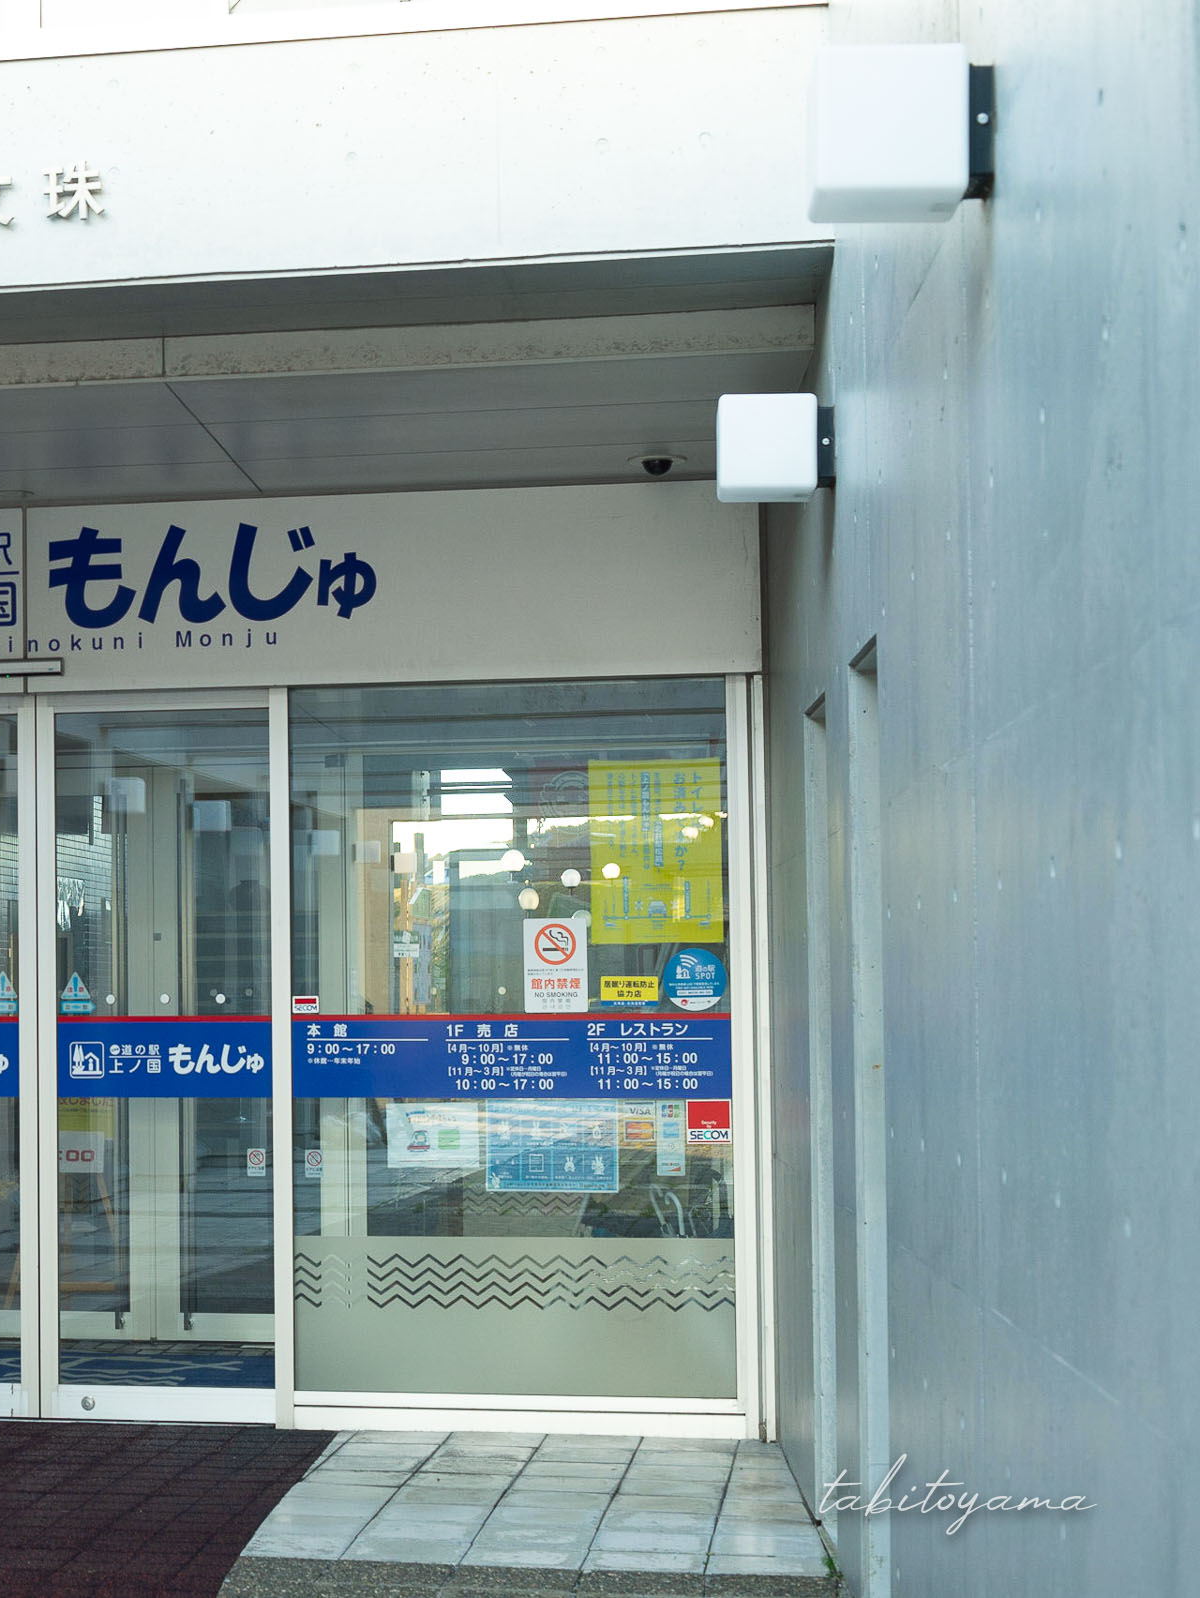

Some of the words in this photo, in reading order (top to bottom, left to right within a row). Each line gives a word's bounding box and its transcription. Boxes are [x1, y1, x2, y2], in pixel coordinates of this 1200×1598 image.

[48, 522, 377, 630] もんじゅ
[175, 629, 278, 649] Monju
[695, 972, 716, 980] SPOT
[531, 978, 581, 990] 館内禁煙
[603, 980, 655, 989] 居眠り運転防止
[307, 1023, 348, 1038] 本館
[446, 1024, 464, 1038] 1F
[477, 1023, 519, 1038] 売店
[587, 1023, 606, 1036] 2F
[620, 1023, 689, 1036] レストラン
[121, 1044, 161, 1056] 道の駅
[168, 1043, 265, 1075] もんじゅ
[108, 1058, 162, 1074] 上ノ国
[629, 1107, 652, 1115] VISA
[690, 1130, 729, 1140] SECOM
